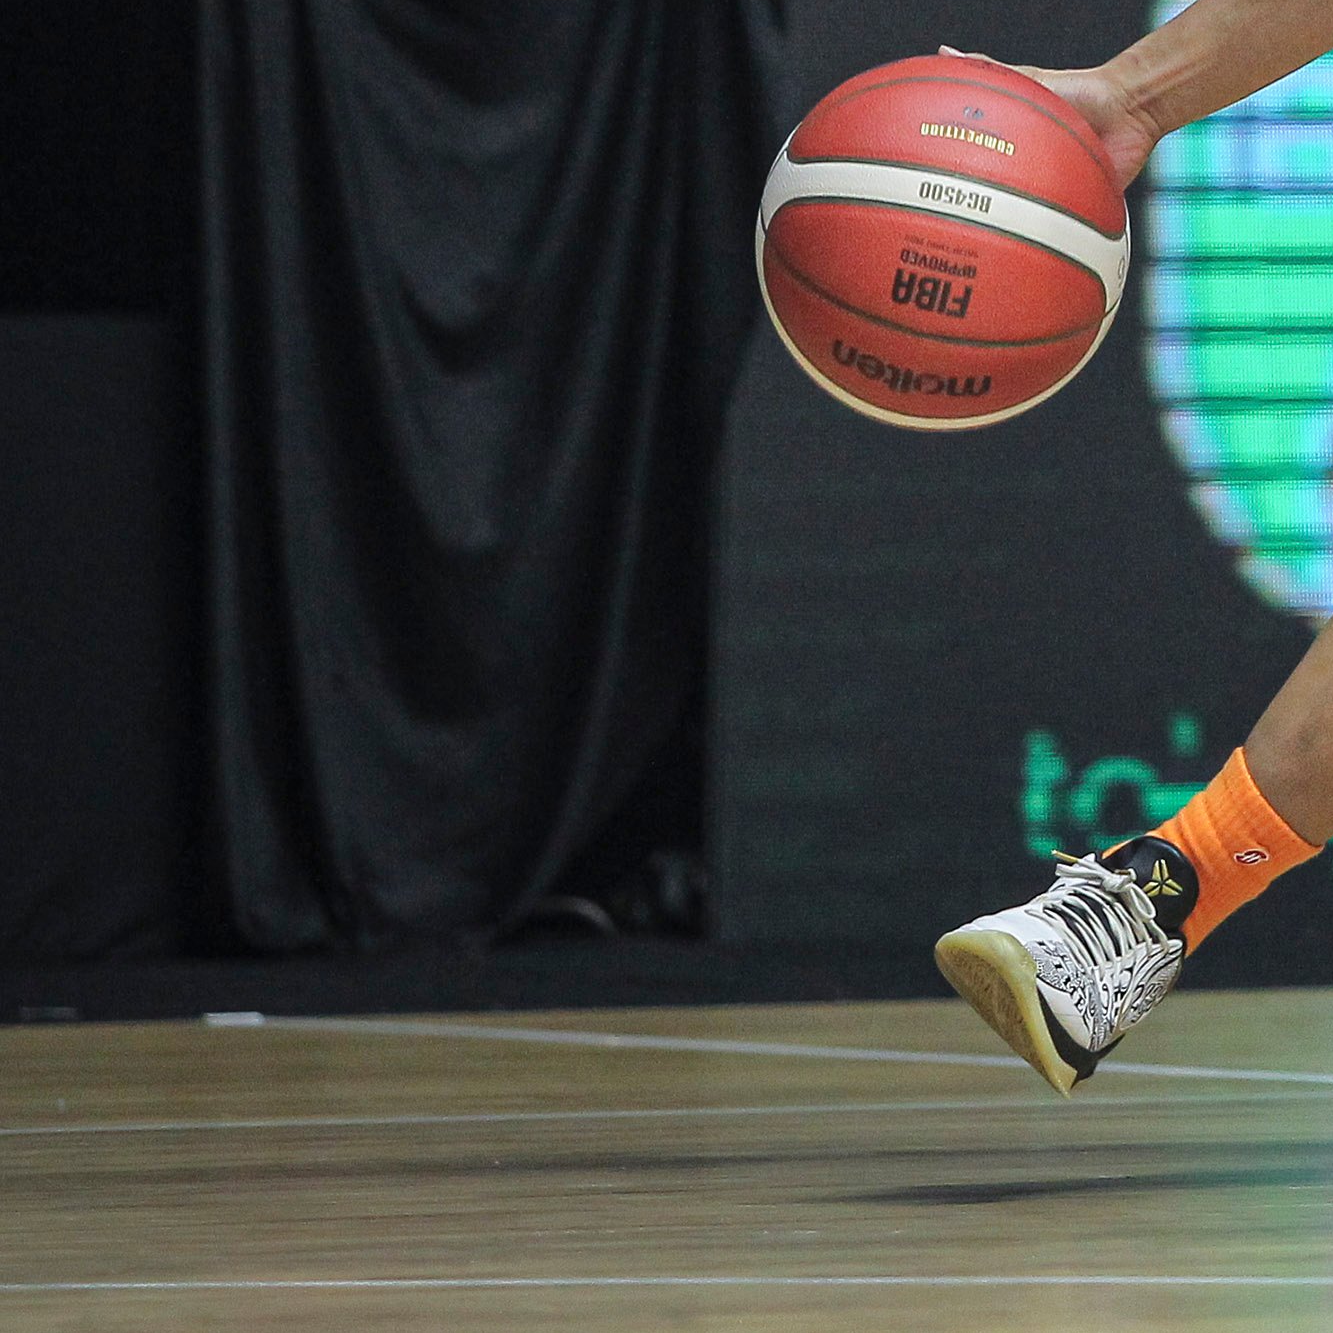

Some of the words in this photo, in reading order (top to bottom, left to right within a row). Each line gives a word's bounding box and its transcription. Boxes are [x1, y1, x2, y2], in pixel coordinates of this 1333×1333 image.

[920, 122, 1015, 156] COMPETITION
[918, 181, 992, 214] BG4500
[900, 249, 978, 279] APPROVED
[891, 268, 973, 319] FIBA
[832, 338, 993, 398] molten
